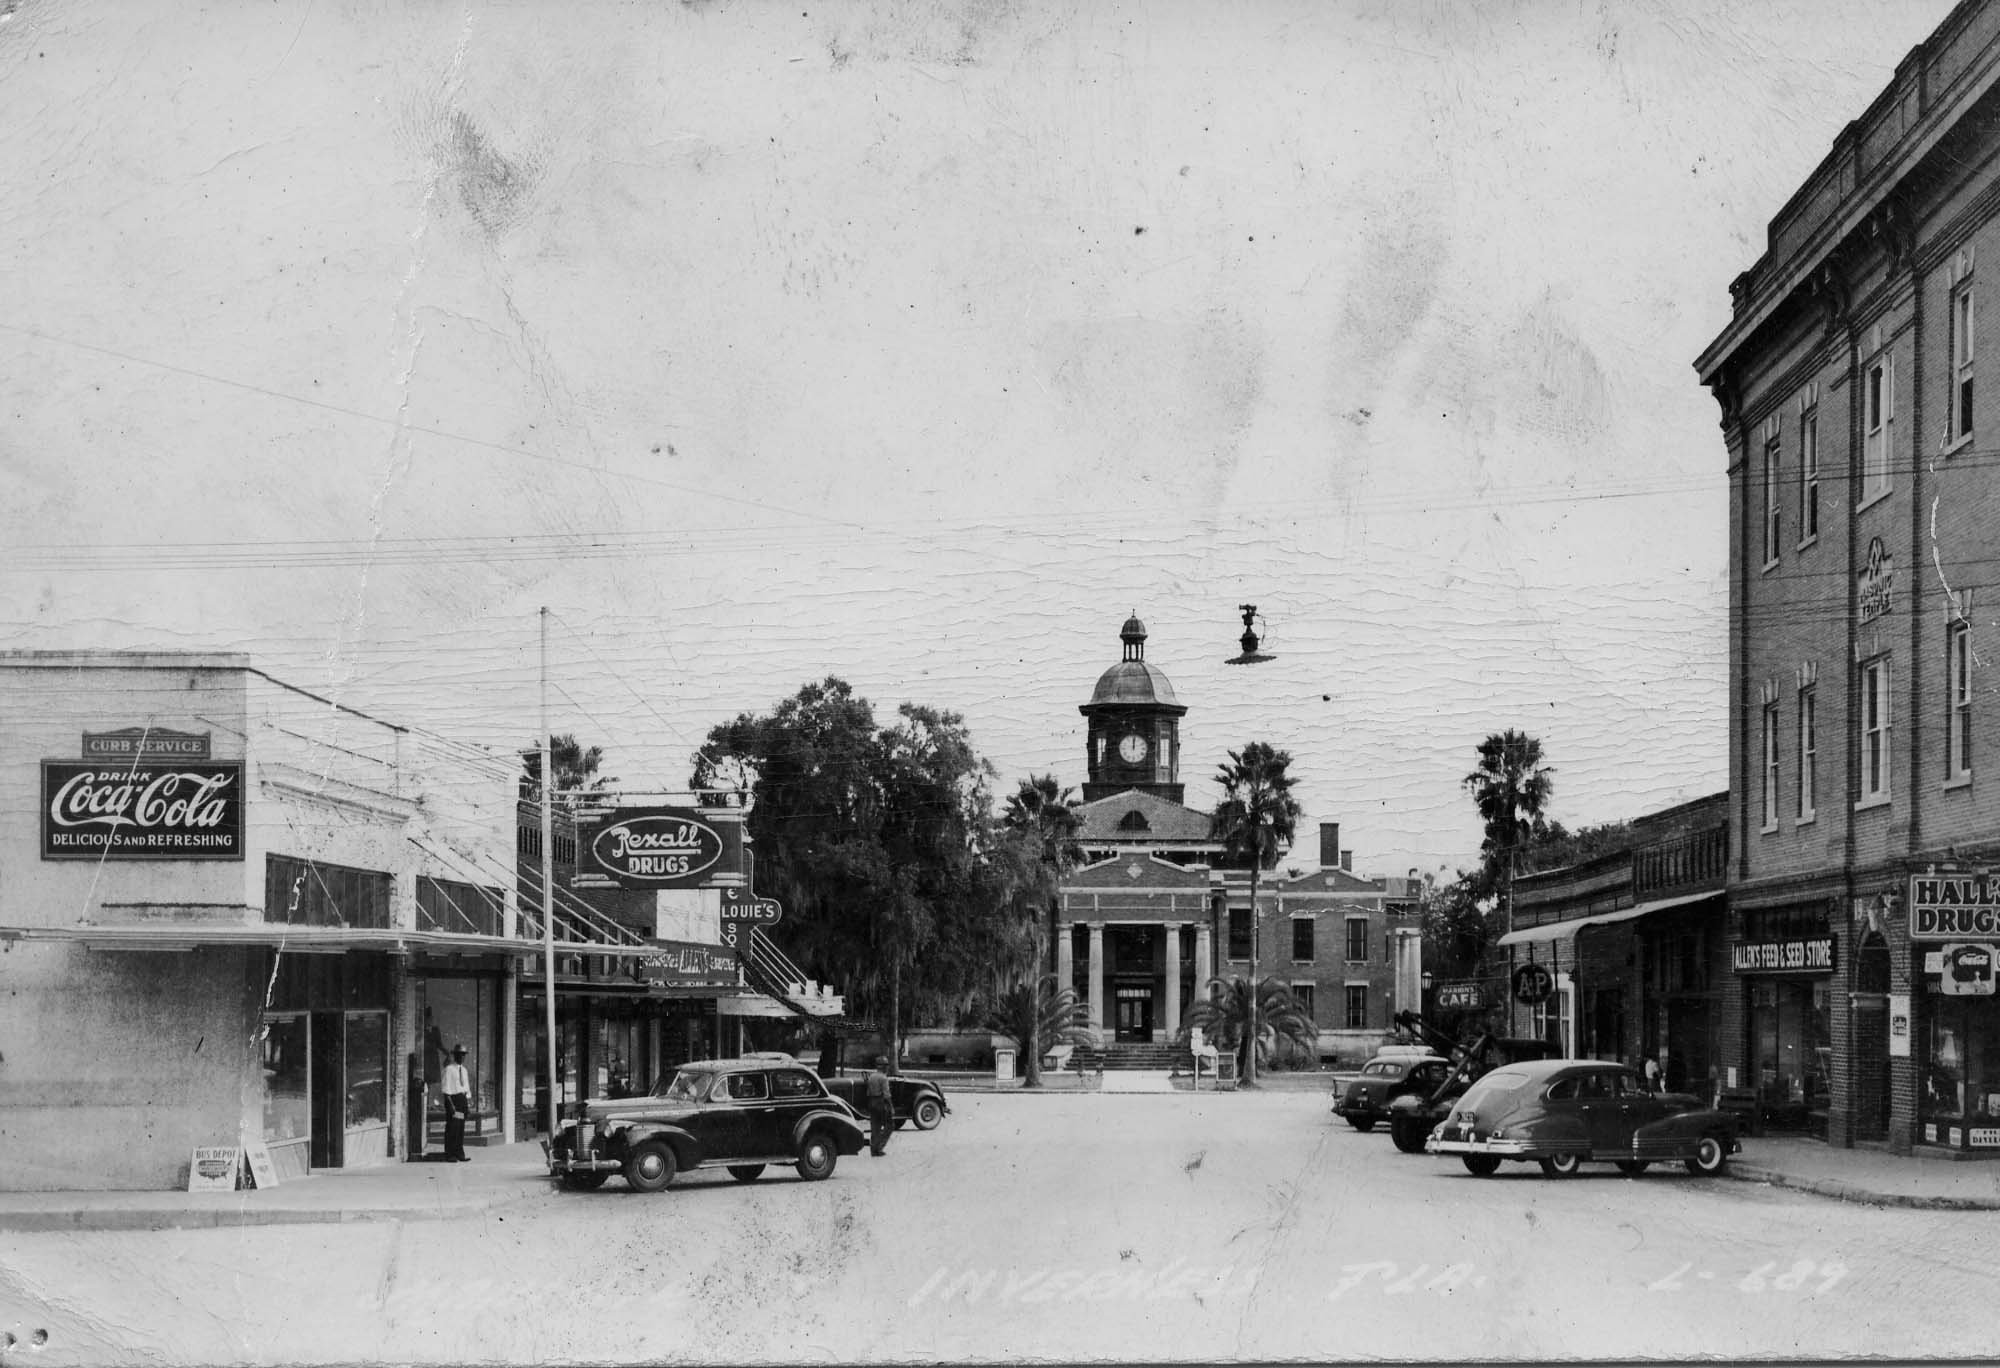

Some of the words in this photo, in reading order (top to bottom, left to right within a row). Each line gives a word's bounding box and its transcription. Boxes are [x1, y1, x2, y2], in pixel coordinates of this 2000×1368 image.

[90, 739, 131, 752] CURB
[135, 739, 202, 752] SERVICE
[98, 771, 152, 782] DRINK
[50, 771, 234, 827] Coca-Cola
[52, 833, 122, 847] DELICIOUS
[125, 836, 146, 846] AND
[148, 833, 233, 847] REFRESHING
[610, 825, 702, 858] Rexall
[628, 857, 690, 874] DRUGS
[721, 903, 775, 919] LOUIE'S
[1735, 944, 1760, 969] ALLEN'S
[1762, 943, 1779, 968] FEED
[1786, 941, 1804, 968] SEED
[1806, 939, 1832, 967] STORE
[1439, 993, 1479, 1008] CAFE
[196, 1150, 210, 1159] BUS
[213, 1150, 236, 1159] DEPOT
